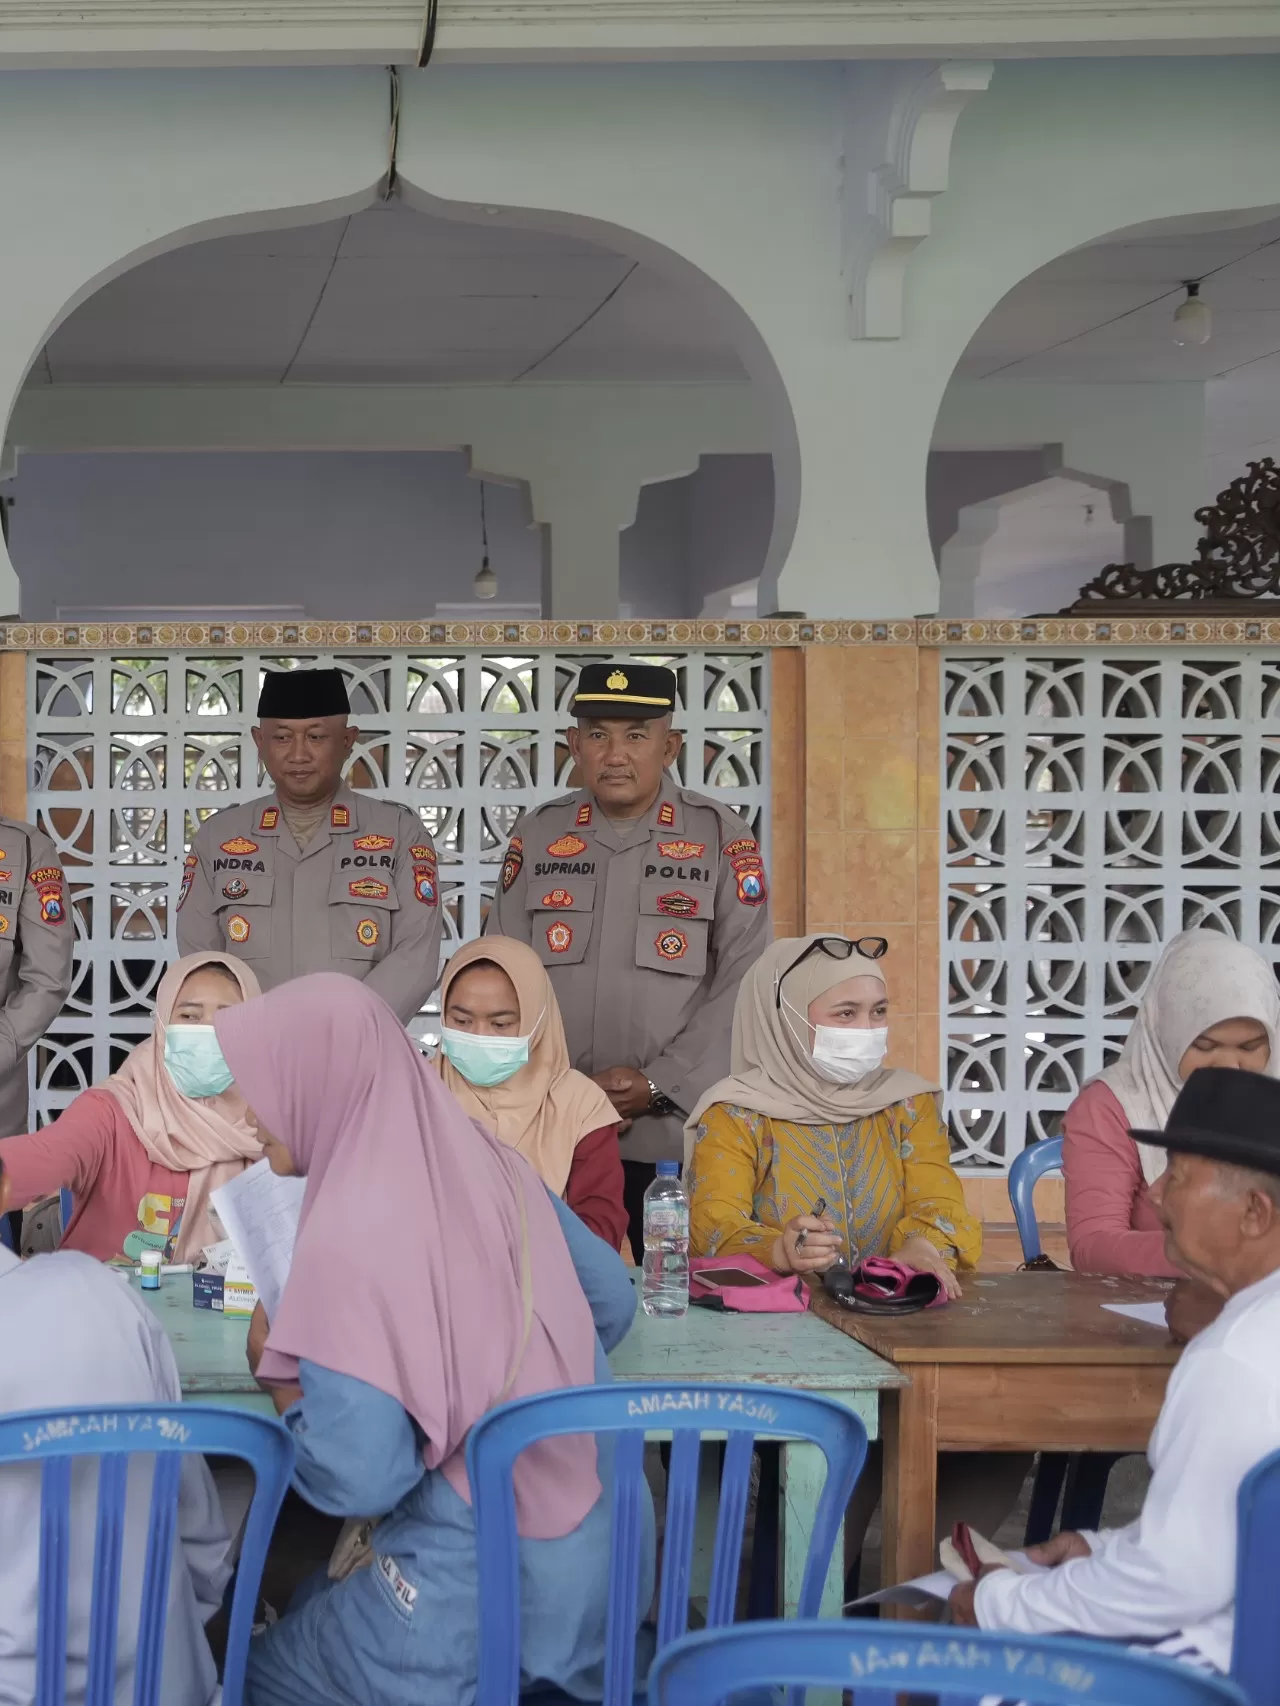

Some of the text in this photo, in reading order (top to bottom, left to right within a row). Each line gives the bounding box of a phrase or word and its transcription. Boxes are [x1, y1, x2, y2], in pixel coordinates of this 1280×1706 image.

[214, 858, 265, 873] INDRA
[341, 855, 396, 871] POLRI
[534, 862, 595, 876] SUPRIADI
[644, 864, 709, 882] POLRI
[716, 1392, 779, 1425] YASIN
